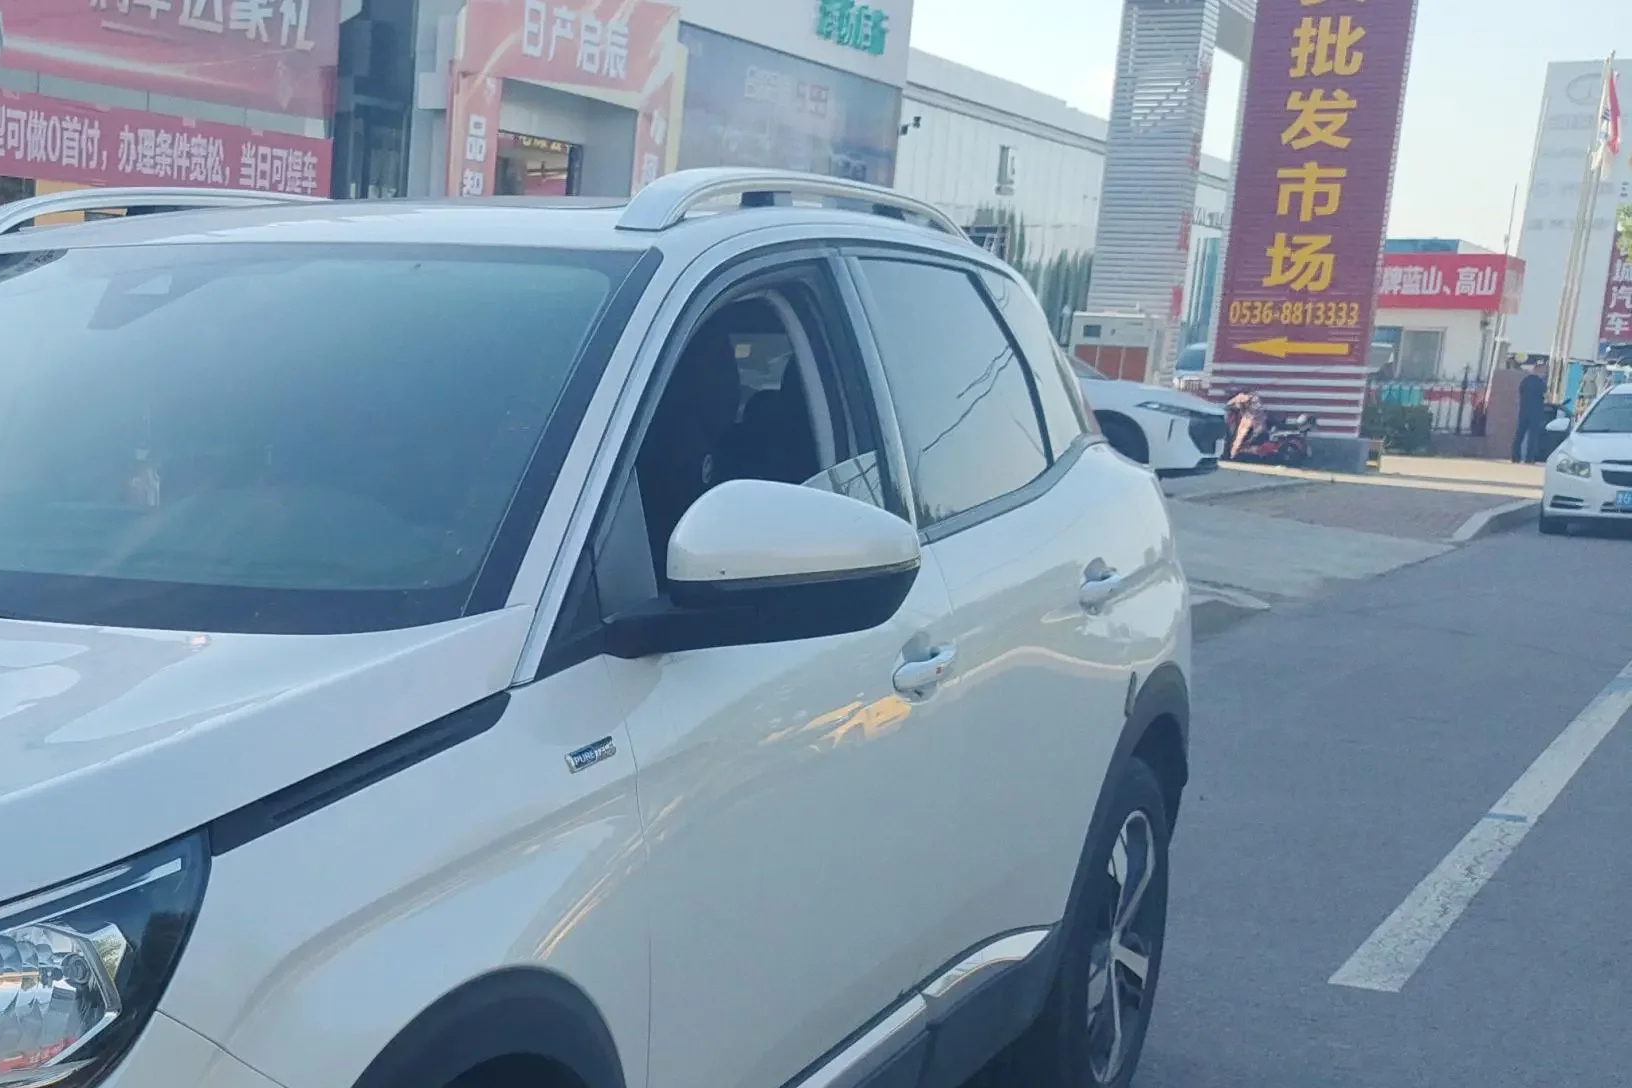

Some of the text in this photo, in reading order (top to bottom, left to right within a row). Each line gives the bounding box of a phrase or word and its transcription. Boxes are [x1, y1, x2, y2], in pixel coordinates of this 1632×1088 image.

[522, 0, 629, 79] 日产启辰
[1262, 0, 1367, 291] 批发市场
[1229, 301, 1359, 326] 0536-8813333
